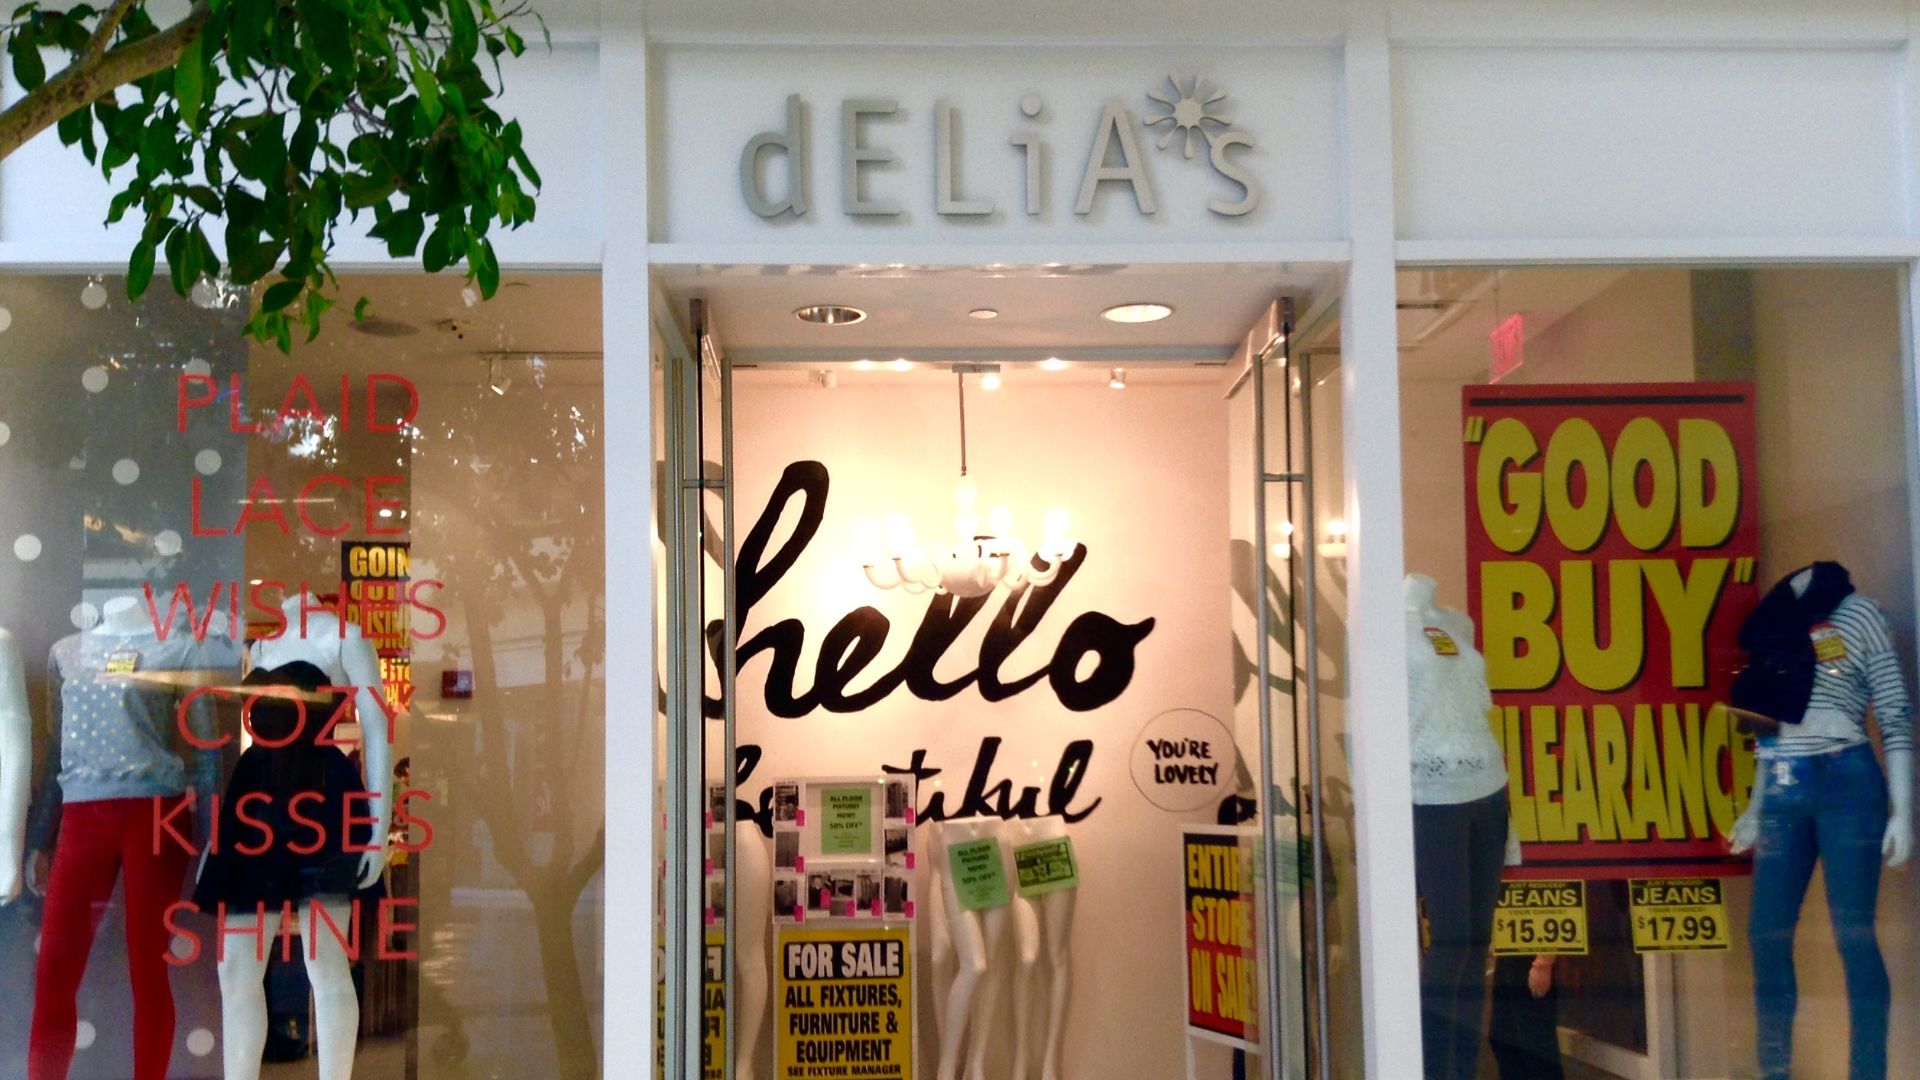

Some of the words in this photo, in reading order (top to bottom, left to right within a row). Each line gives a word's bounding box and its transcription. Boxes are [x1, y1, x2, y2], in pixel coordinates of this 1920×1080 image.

[176, 373, 419, 433] PLAID
[190, 476, 404, 537] LACE
[706, 459, 1156, 719] hello
[142, 580, 447, 642] WISHES
[177, 685, 417, 749] COZY
[1146, 738, 1212, 760] YOU'RE
[1154, 762, 1219, 786] LOVELY
[1485, 702, 1757, 843] LEARANCE
[151, 790, 434, 855] KISSES
[1497, 889, 1578, 907] JEANS
[1636, 887, 1716, 905] JEANS
[161, 898, 418, 966] SHINE
[1496, 918, 1577, 943] $15.99
[1638, 915, 1717, 941] $17.99
[788, 943, 834, 978] FOR
[841, 941, 900, 978] SALE
[785, 985, 814, 1008] ALL
[820, 983, 902, 1008] FIXTURES,
[1191, 947, 1213, 1015] ON
[789, 1012, 880, 1035] FURNITURE
[886, 1011, 898, 1034] &
[796, 1039, 892, 1063] EQUIPMENT
[788, 1066, 804, 1077] SEE
[808, 1065, 848, 1076] FIXTURE
[851, 1064, 901, 1076] MANAGER
